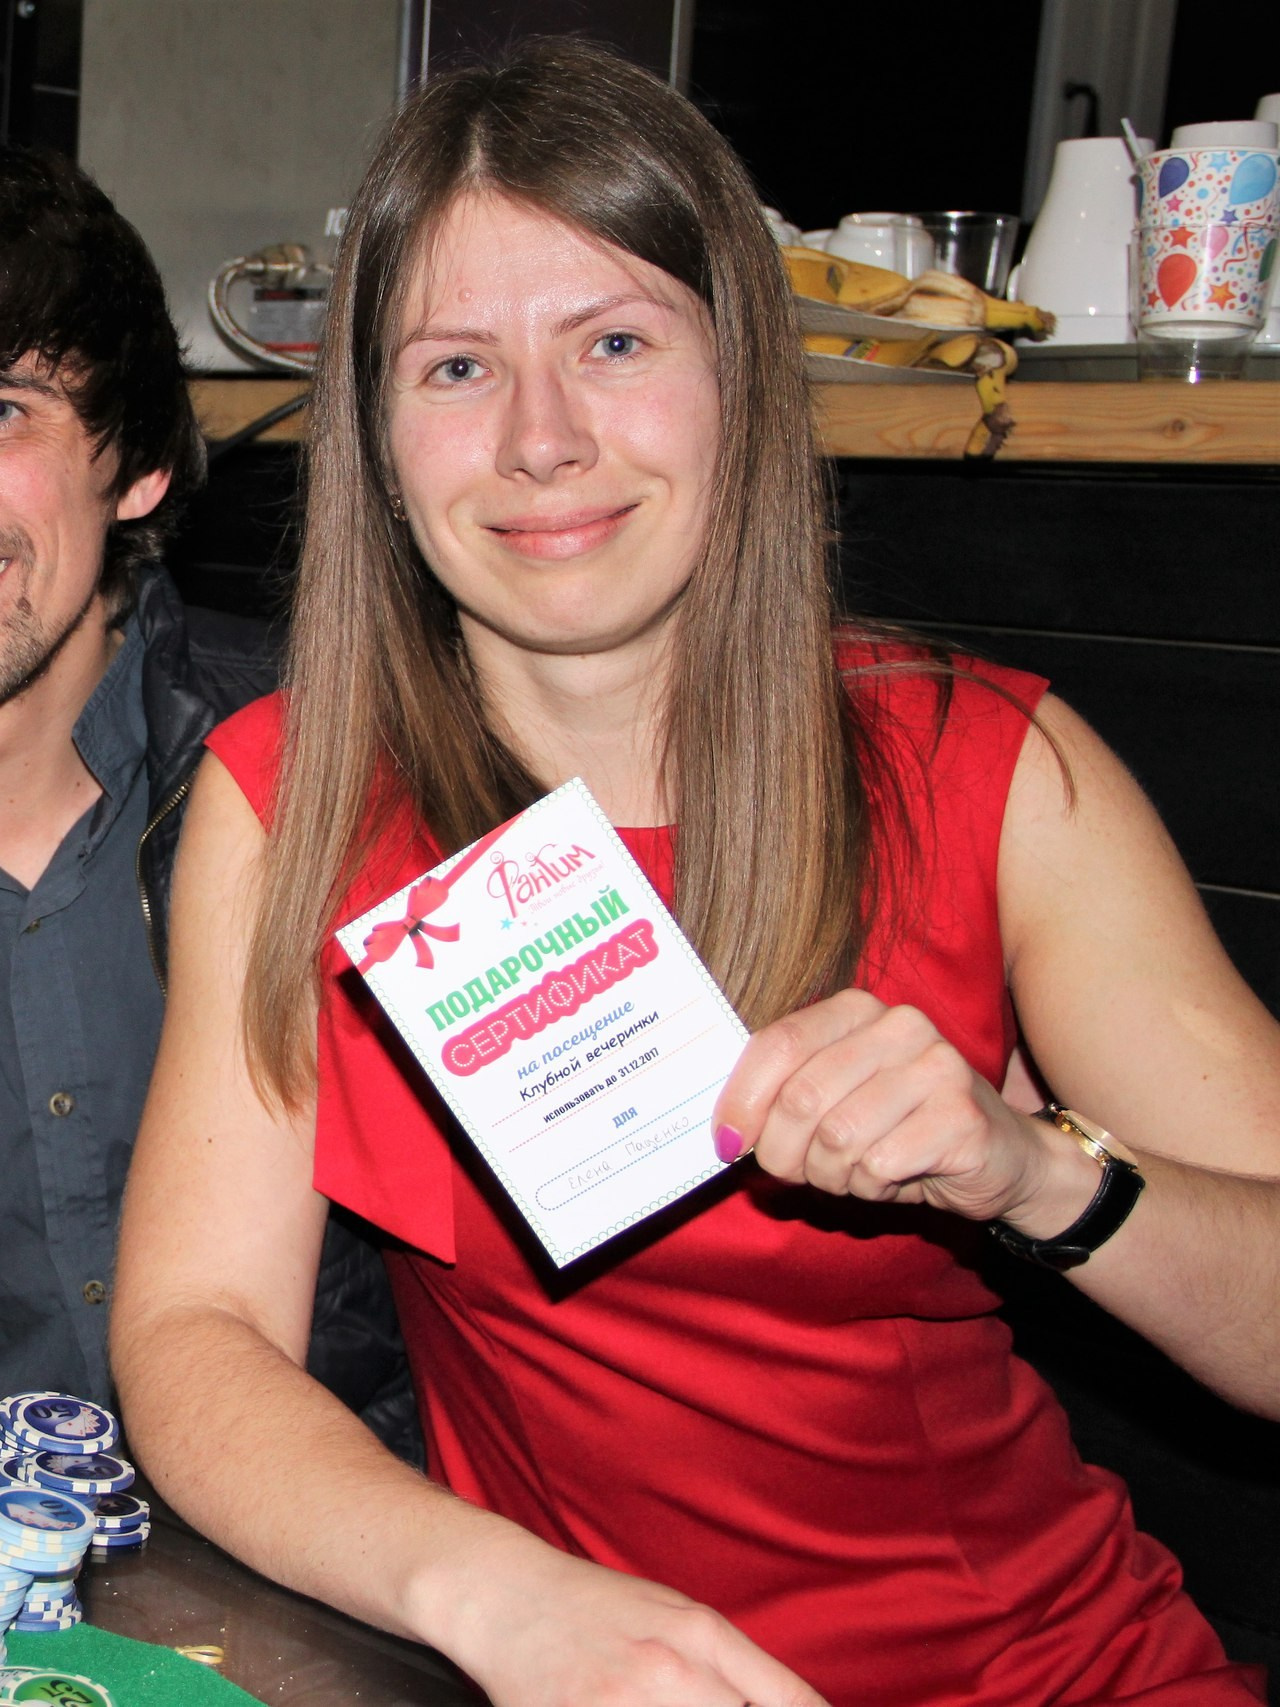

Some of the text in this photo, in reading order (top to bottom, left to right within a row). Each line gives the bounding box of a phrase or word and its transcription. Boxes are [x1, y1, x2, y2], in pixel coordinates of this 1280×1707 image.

[425, 884, 631, 1032] ПОДАРОЧНЫЙ
[450, 928, 650, 1068] СЕРТИФИКАТ
[517, 1000, 635, 1080] на посещение
[519, 1011, 660, 1102] Клубной вечеринки
[543, 1047, 660, 1123] использовать до 31.12.2017
[567, 1160, 612, 1190] Елена
